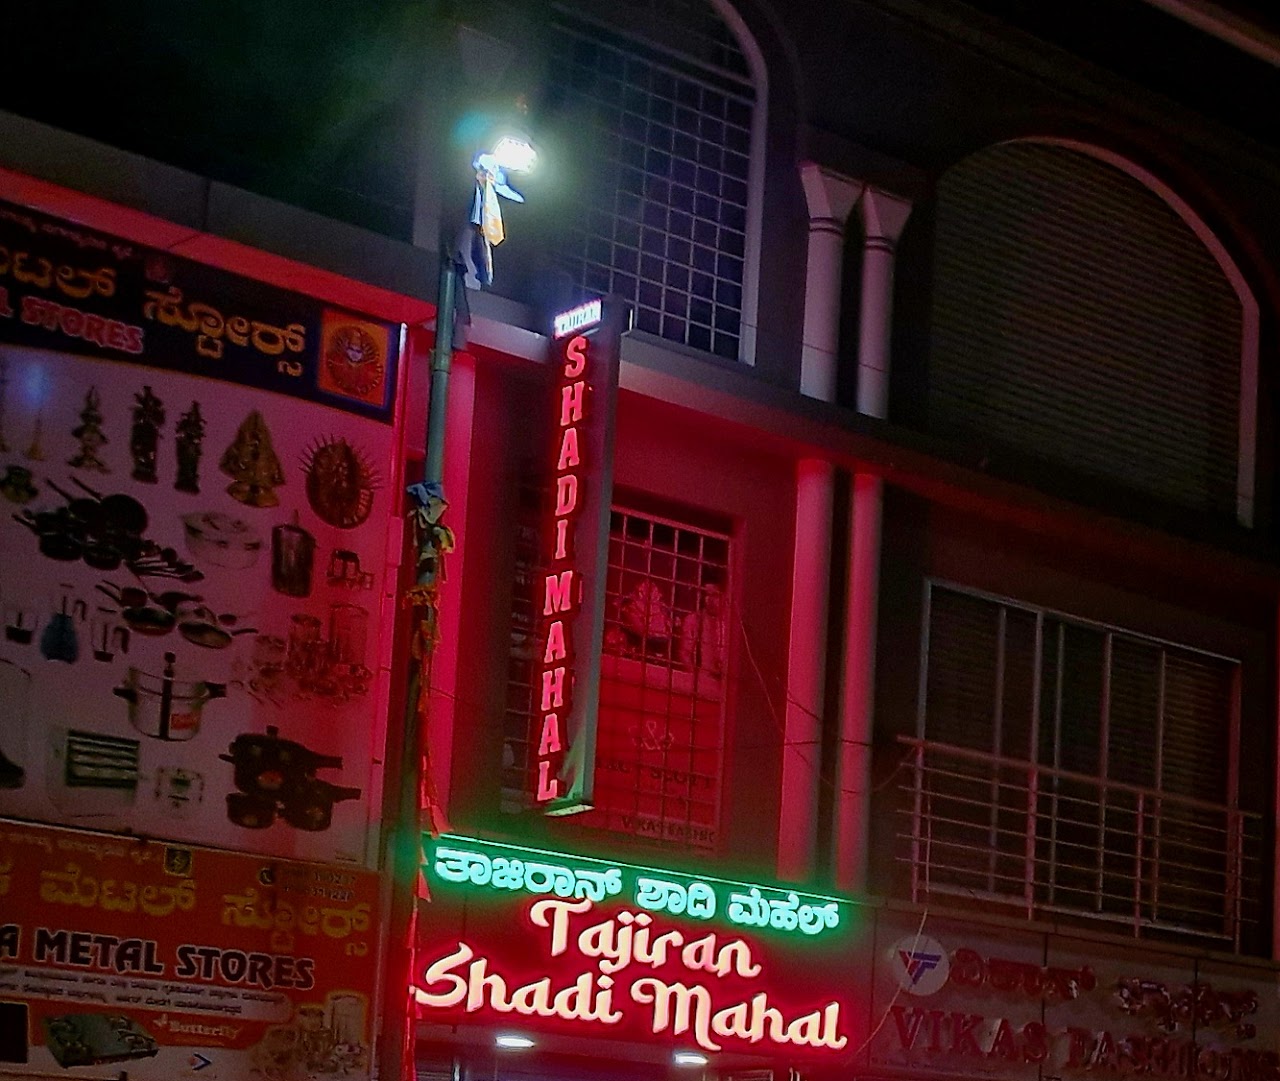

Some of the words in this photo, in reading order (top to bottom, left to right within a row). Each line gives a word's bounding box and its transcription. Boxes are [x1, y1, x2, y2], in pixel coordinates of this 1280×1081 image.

[20, 295, 145, 355] STORES
[555, 335, 587, 559] SHADI
[537, 570, 574, 800] MAHAL
[636, 876, 716, 920] ಶಾದಿ
[34, 927, 165, 976] METAL
[176, 945, 315, 991] STORES
[530, 899, 762, 978] Tajiran
[414, 942, 624, 1024] Shadi
[630, 977, 848, 1051] Mahal
[890, 1005, 1048, 1064] VIKAS
